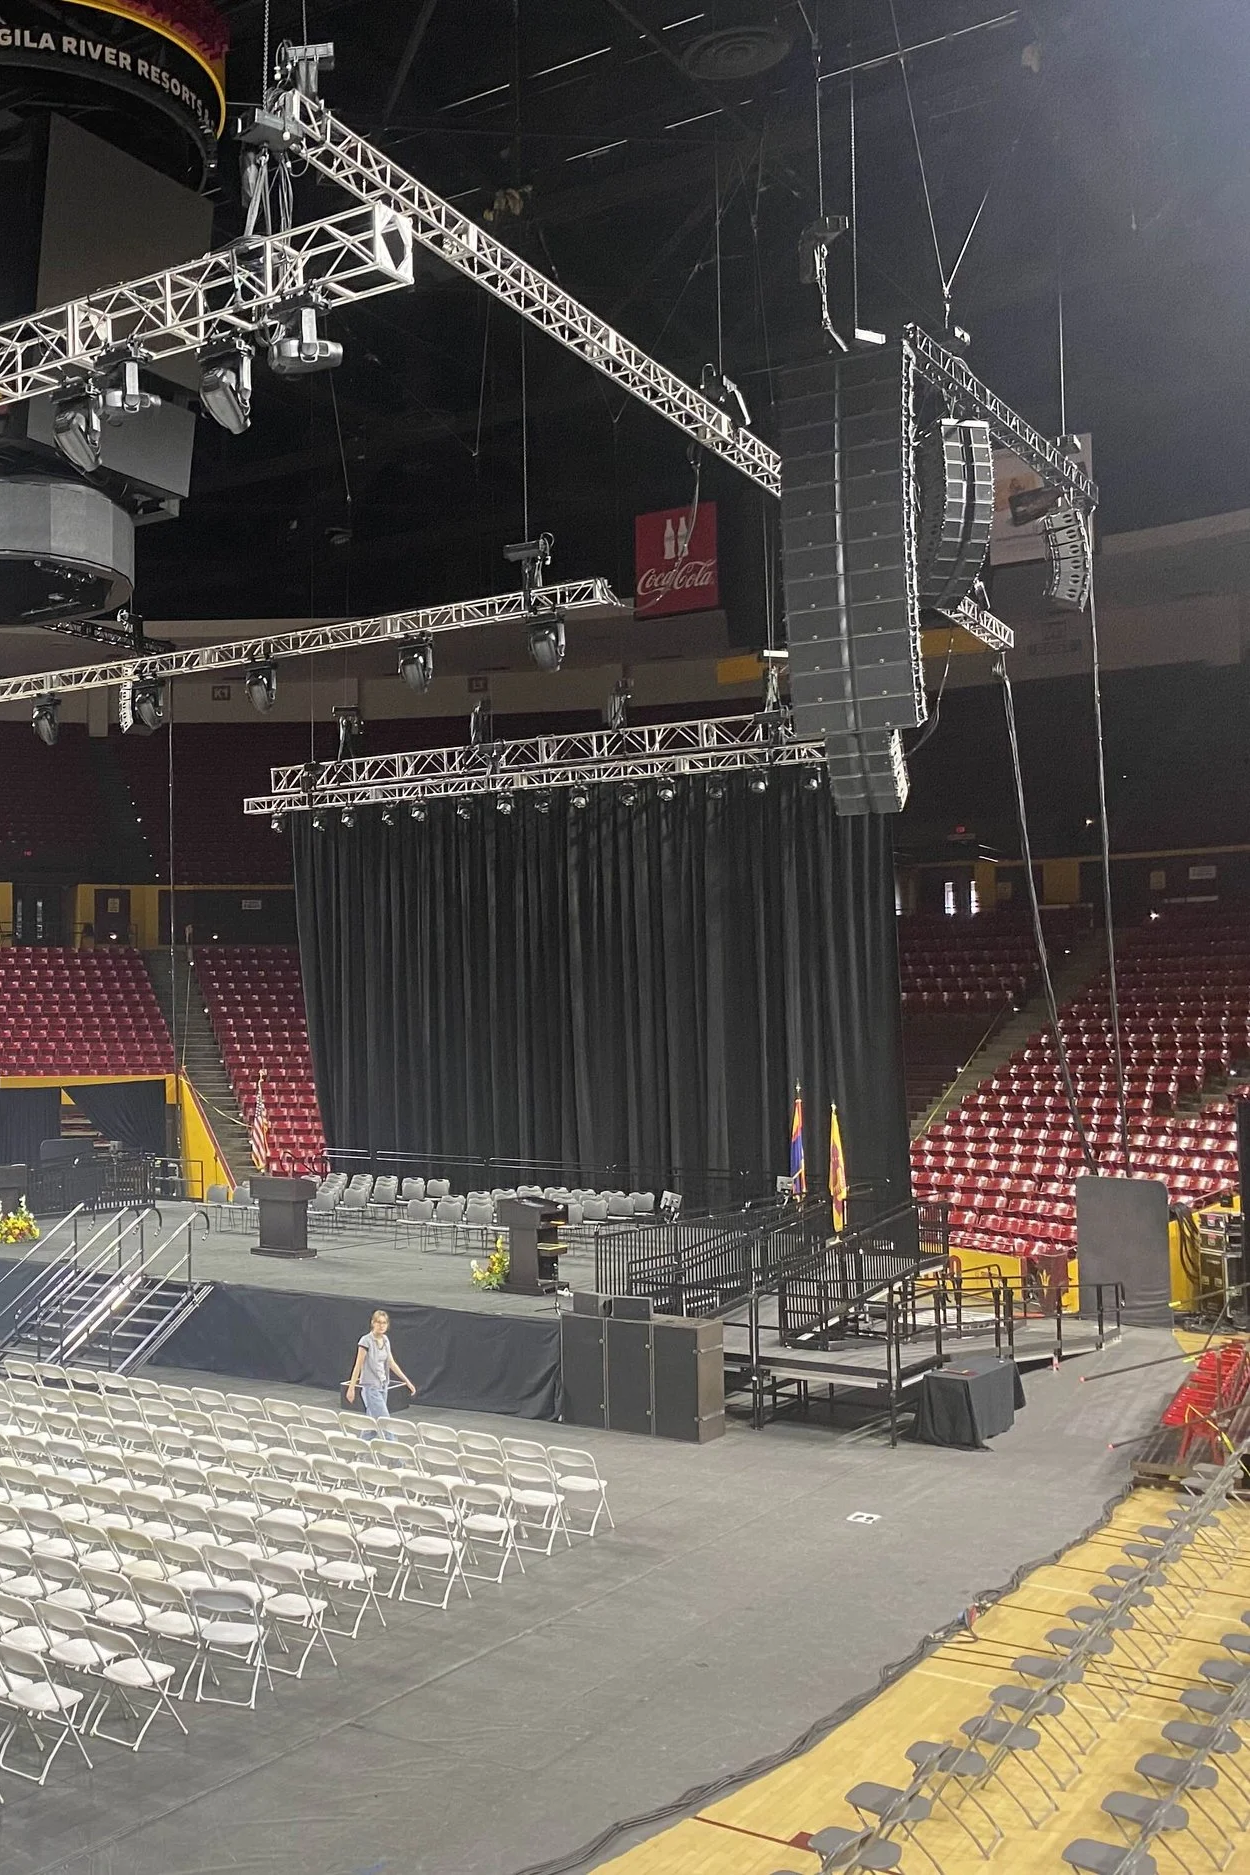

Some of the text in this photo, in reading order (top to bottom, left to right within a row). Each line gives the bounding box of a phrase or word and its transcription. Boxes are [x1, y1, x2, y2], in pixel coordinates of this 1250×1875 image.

[62, 36, 132, 72] RIVER
[137, 58, 203, 117] RESORTS
[637, 558, 717, 595] CocaCola
[214, 687, 229, 699] K1
